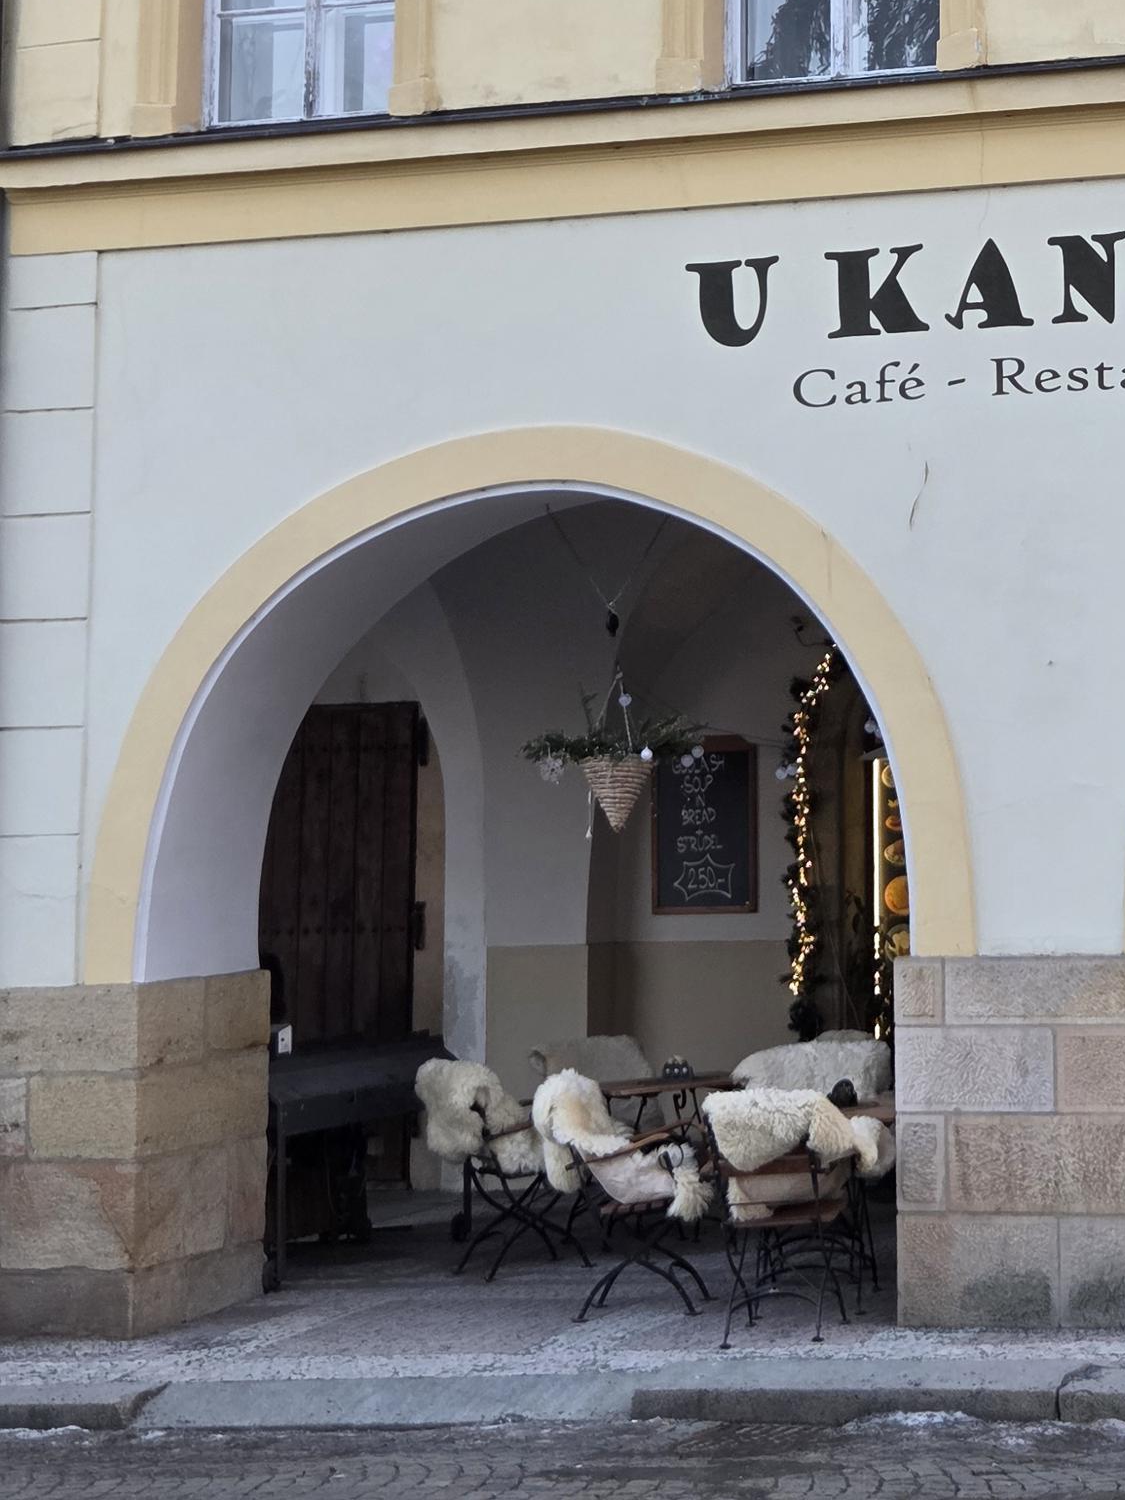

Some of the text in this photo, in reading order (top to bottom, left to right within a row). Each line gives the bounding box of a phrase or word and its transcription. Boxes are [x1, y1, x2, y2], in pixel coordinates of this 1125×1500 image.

[684, 255, 780, 348] U
[792, 361, 926, 408] Café
[681, 807, 717, 826] BREAD
